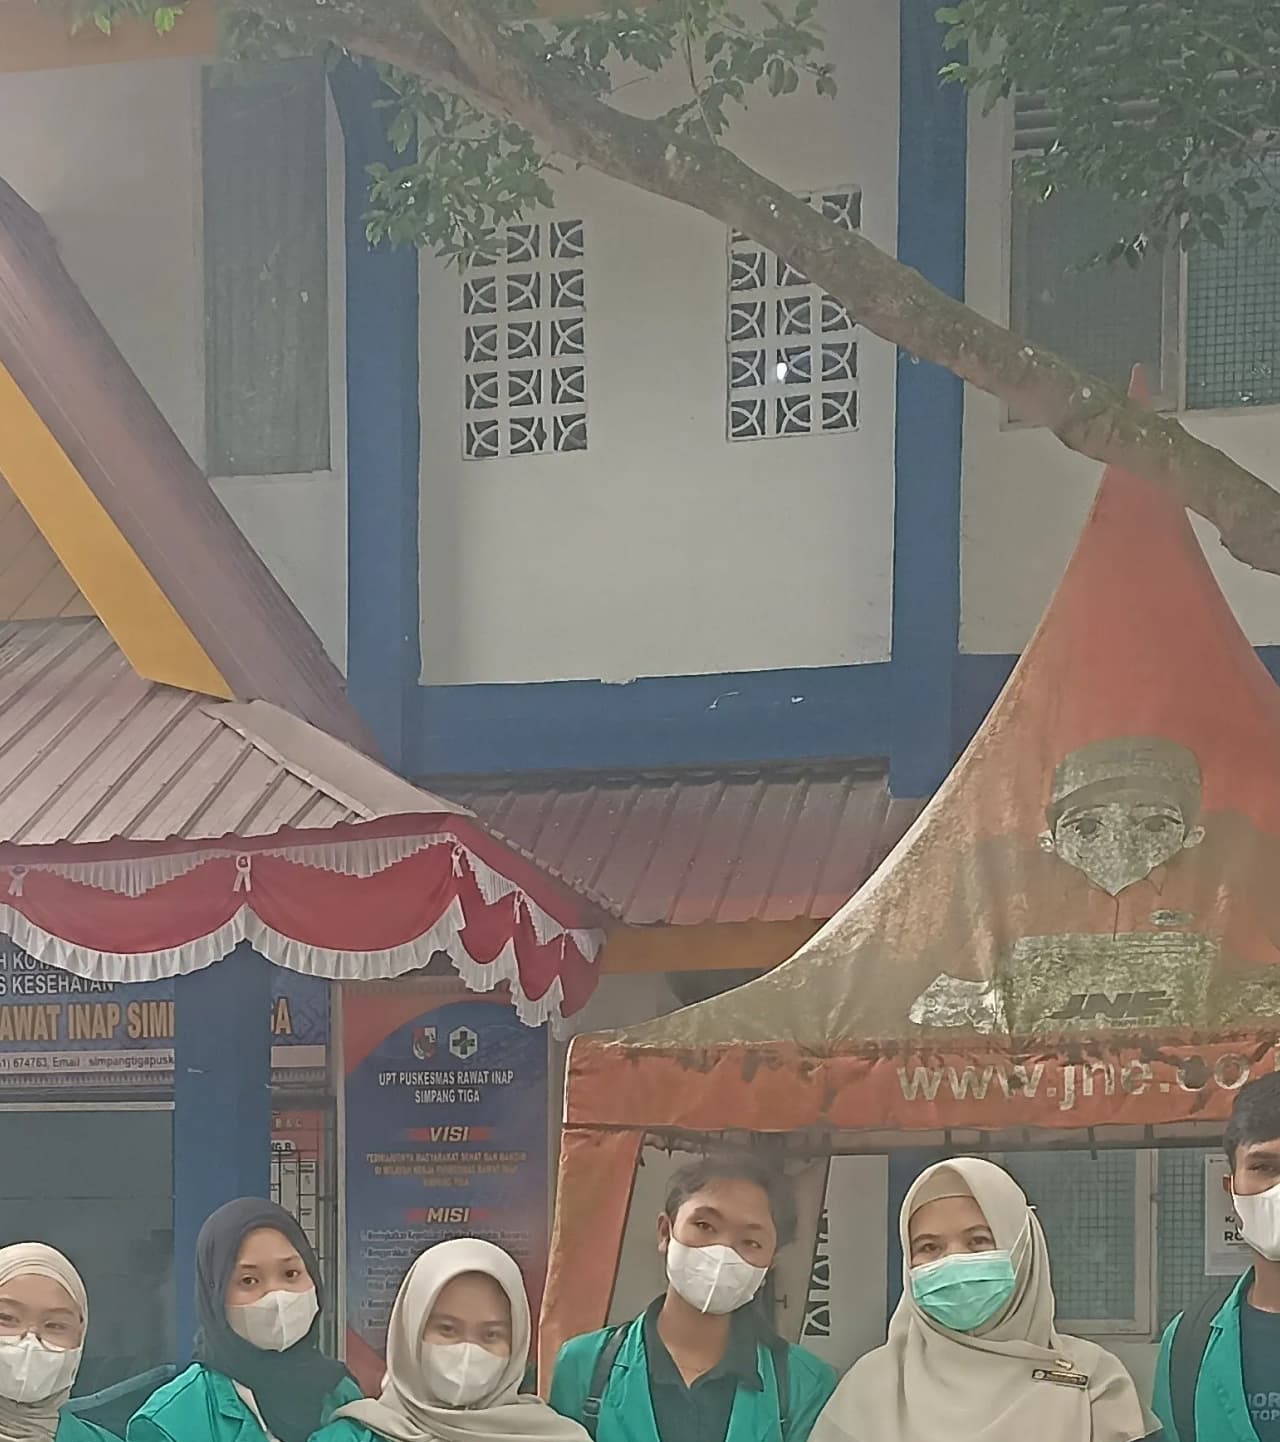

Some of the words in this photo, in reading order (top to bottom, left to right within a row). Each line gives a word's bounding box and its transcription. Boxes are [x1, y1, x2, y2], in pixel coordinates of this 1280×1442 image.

[12, 952, 66, 972] KO
[68, 1002, 121, 1040] INAP
[378, 1071, 396, 1086] UPT
[399, 1071, 455, 1086] PUSKESMAS
[457, 1070, 490, 1085] RAWAT
[491, 1069, 514, 1084] INAP
[415, 1089, 456, 1104] SIMPANG
[457, 1088, 480, 1103] TIGA
[429, 1126, 470, 1142] VISI
[426, 1207, 470, 1223] MISI
[1250, 1410, 1280, 1421] TOP
